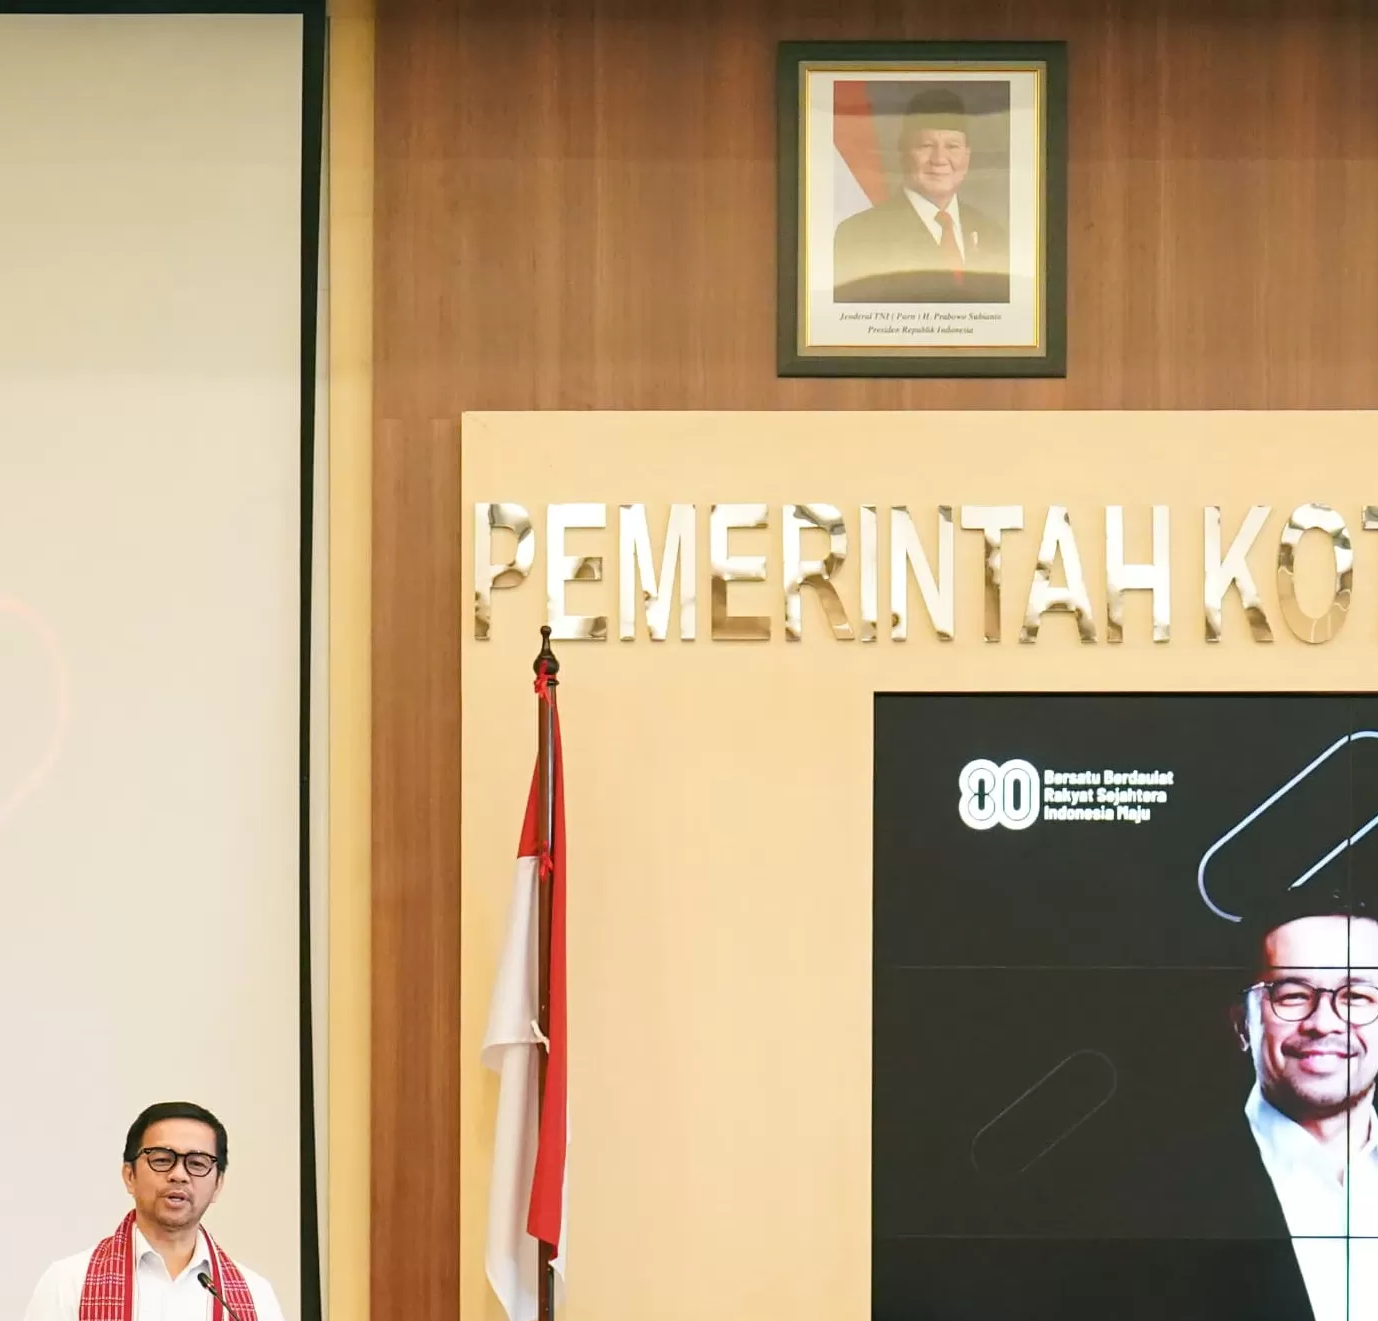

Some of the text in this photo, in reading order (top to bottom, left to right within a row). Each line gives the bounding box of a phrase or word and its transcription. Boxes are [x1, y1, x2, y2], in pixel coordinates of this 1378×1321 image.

[474, 502, 1169, 642] PEMERINTAH
[1043, 770, 1174, 785] Bersatu Berdaulat
[959, 759, 1040, 830] 80
[1044, 788, 1167, 806] Rakyat Sejahtera
[1044, 805, 1151, 824] Indonesia Maju
